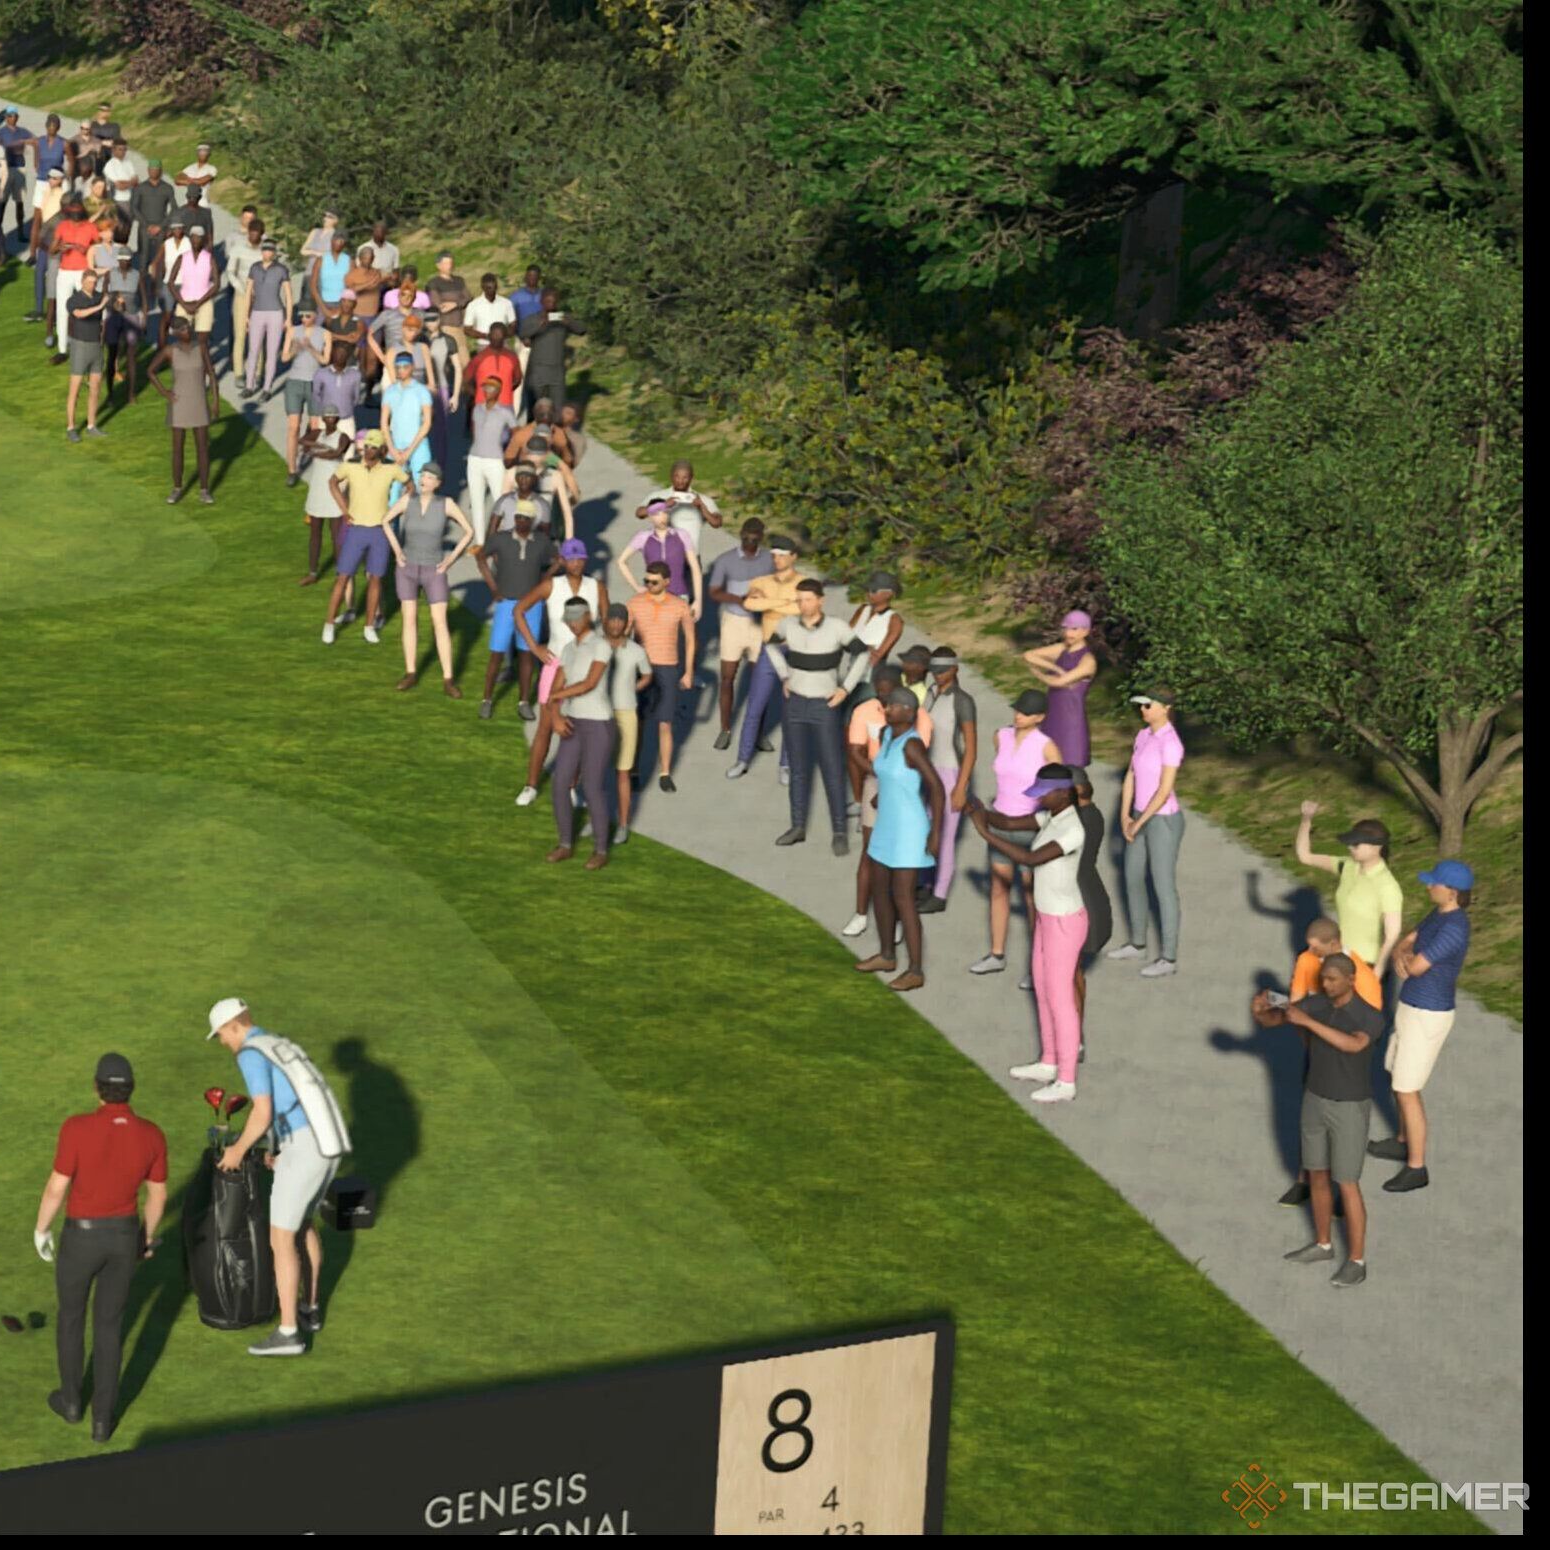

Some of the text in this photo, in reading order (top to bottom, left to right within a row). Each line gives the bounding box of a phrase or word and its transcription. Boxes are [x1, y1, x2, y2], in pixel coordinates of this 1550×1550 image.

[761, 1388, 814, 1473] 8
[424, 1472, 588, 1529] GENESIS
[497, 1509, 638, 1535] NAL
[758, 1486, 840, 1524] PAR 4
